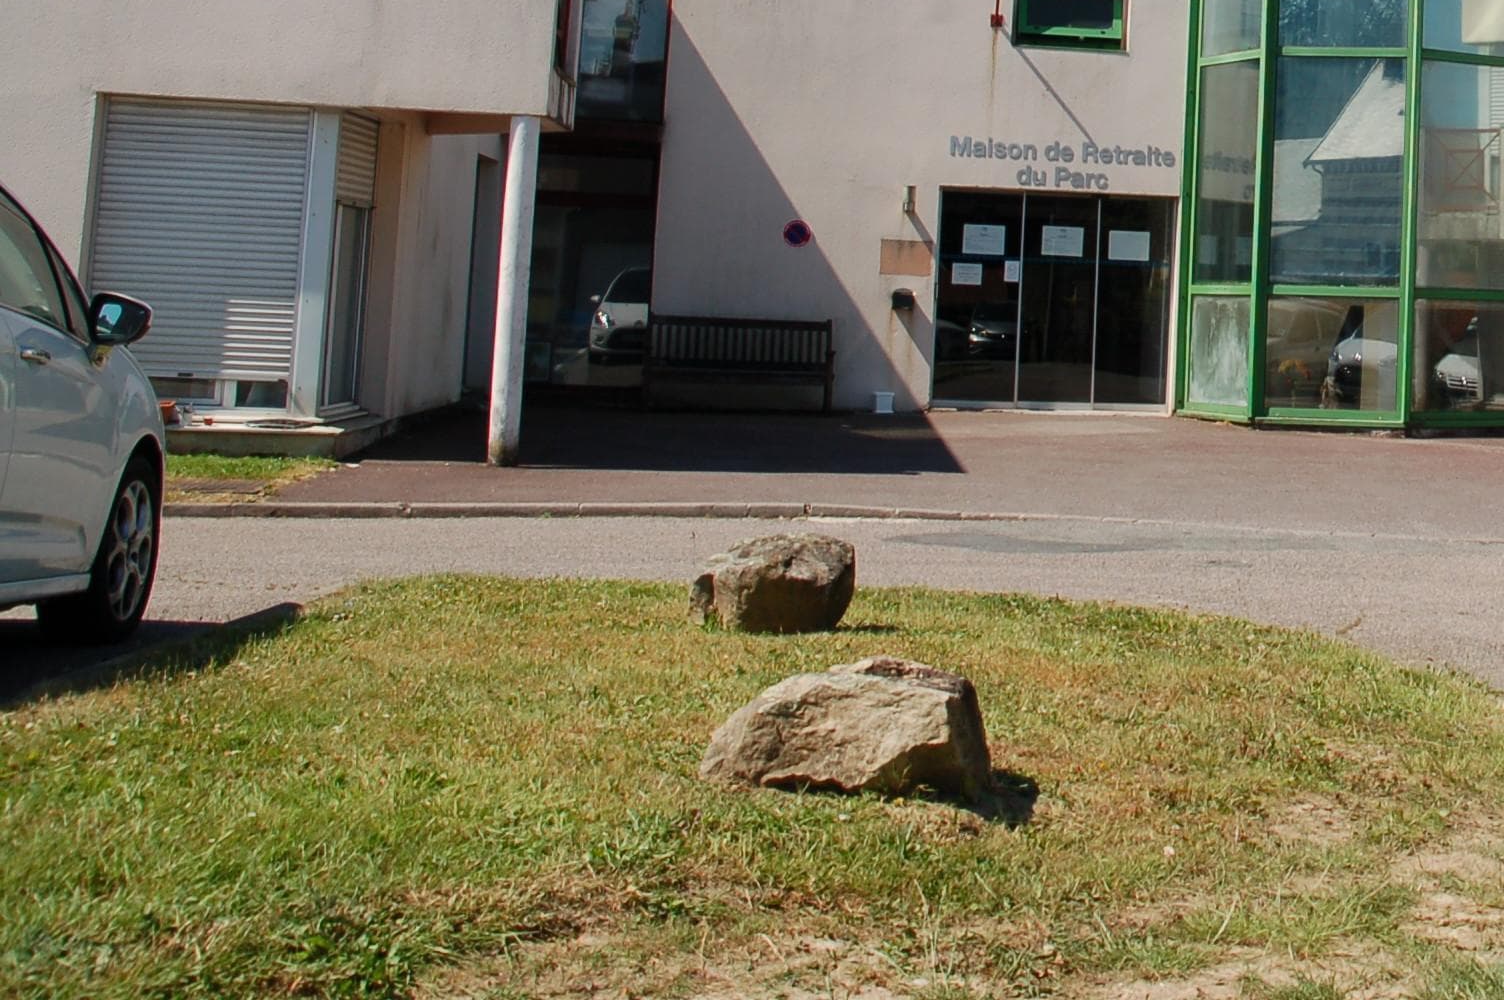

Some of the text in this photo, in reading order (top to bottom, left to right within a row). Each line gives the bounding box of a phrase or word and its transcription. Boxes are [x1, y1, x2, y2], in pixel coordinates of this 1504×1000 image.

[950, 135, 1038, 161] Maison
[1044, 141, 1075, 163] de
[1082, 142, 1176, 168] Retraite
[1016, 165, 1109, 190] du Parc
